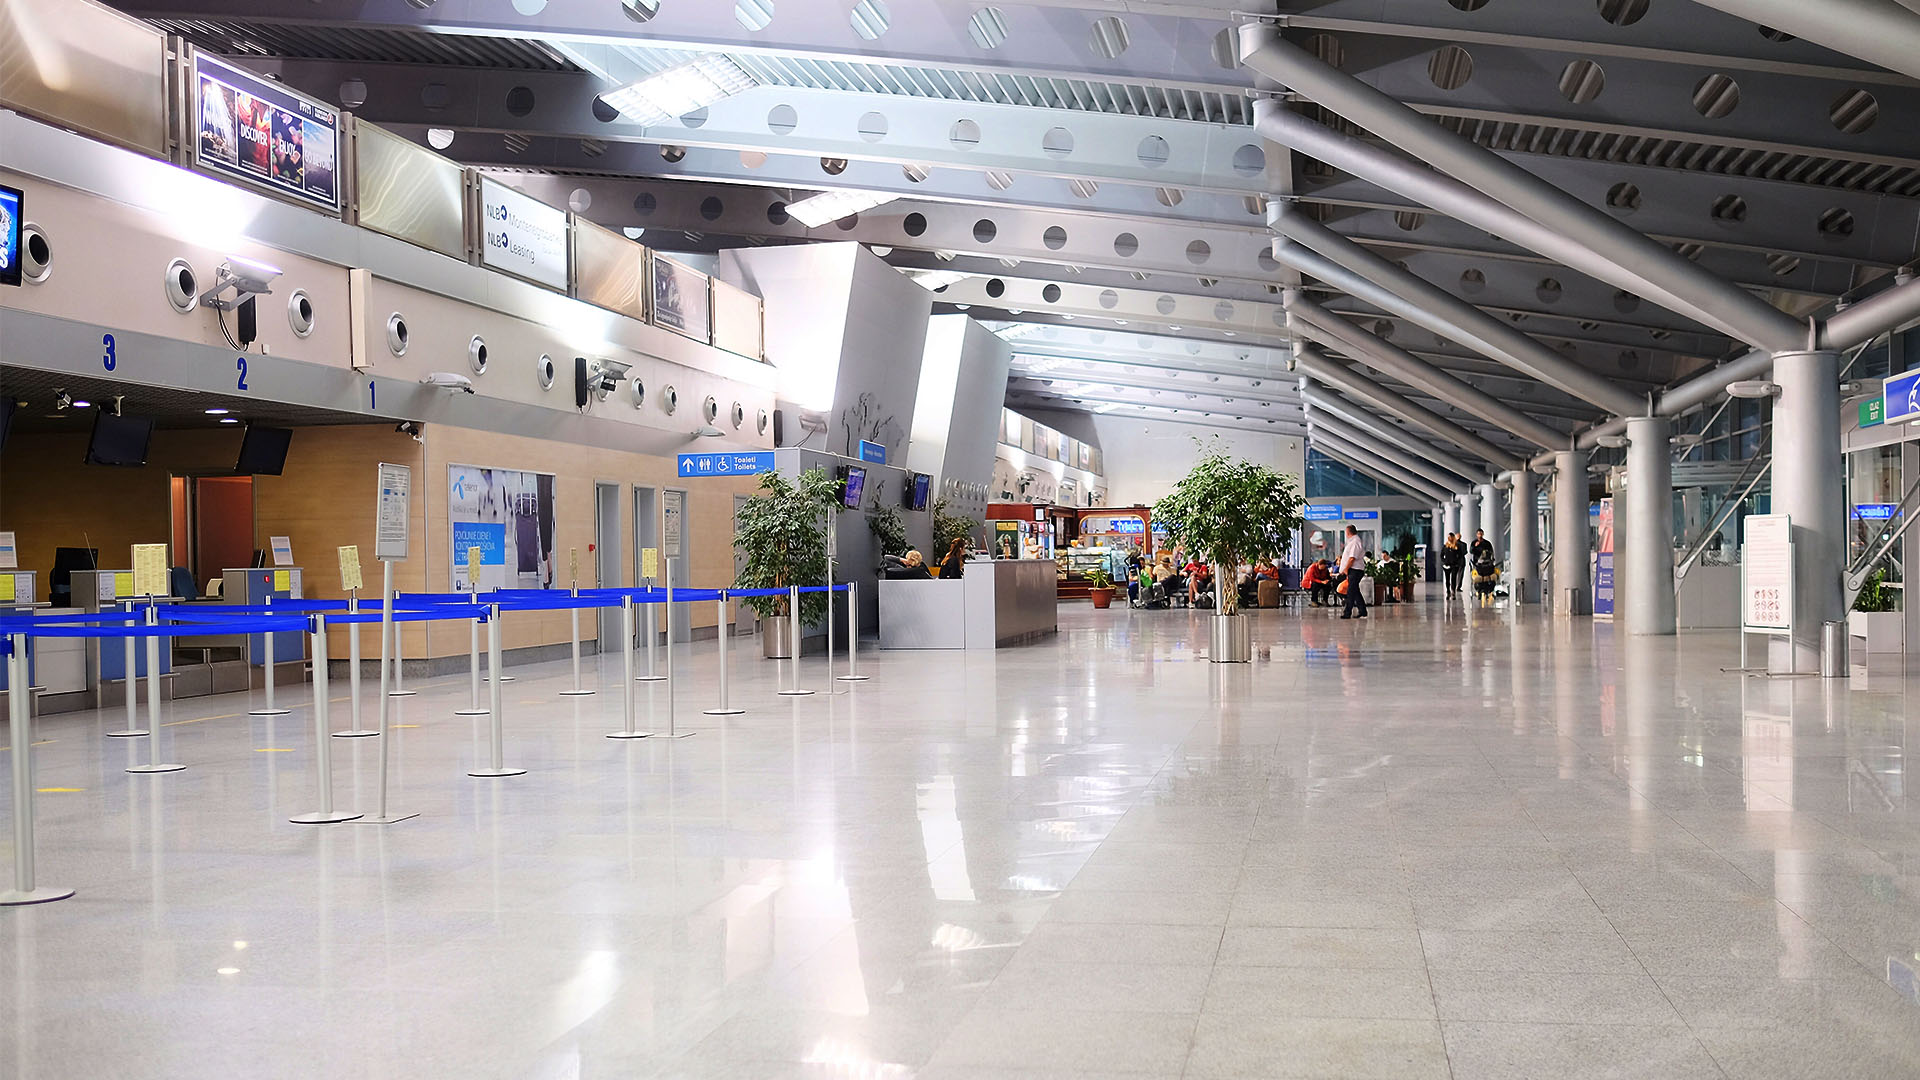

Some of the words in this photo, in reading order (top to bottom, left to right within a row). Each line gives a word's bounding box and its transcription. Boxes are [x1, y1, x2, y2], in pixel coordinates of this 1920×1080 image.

[241, 123, 268, 147] DISCOVER
[279, 138, 297, 157] ENJOY
[486, 203, 501, 221] NLB
[487, 231, 502, 248] NLB
[510, 239, 535, 265] Leasing
[102, 333, 117, 372] 3
[236, 357, 248, 391] 2
[368, 380, 376, 410] 1
[1869, 401, 1880, 411] IZLAZ
[1870, 411, 1879, 421] EXIT
